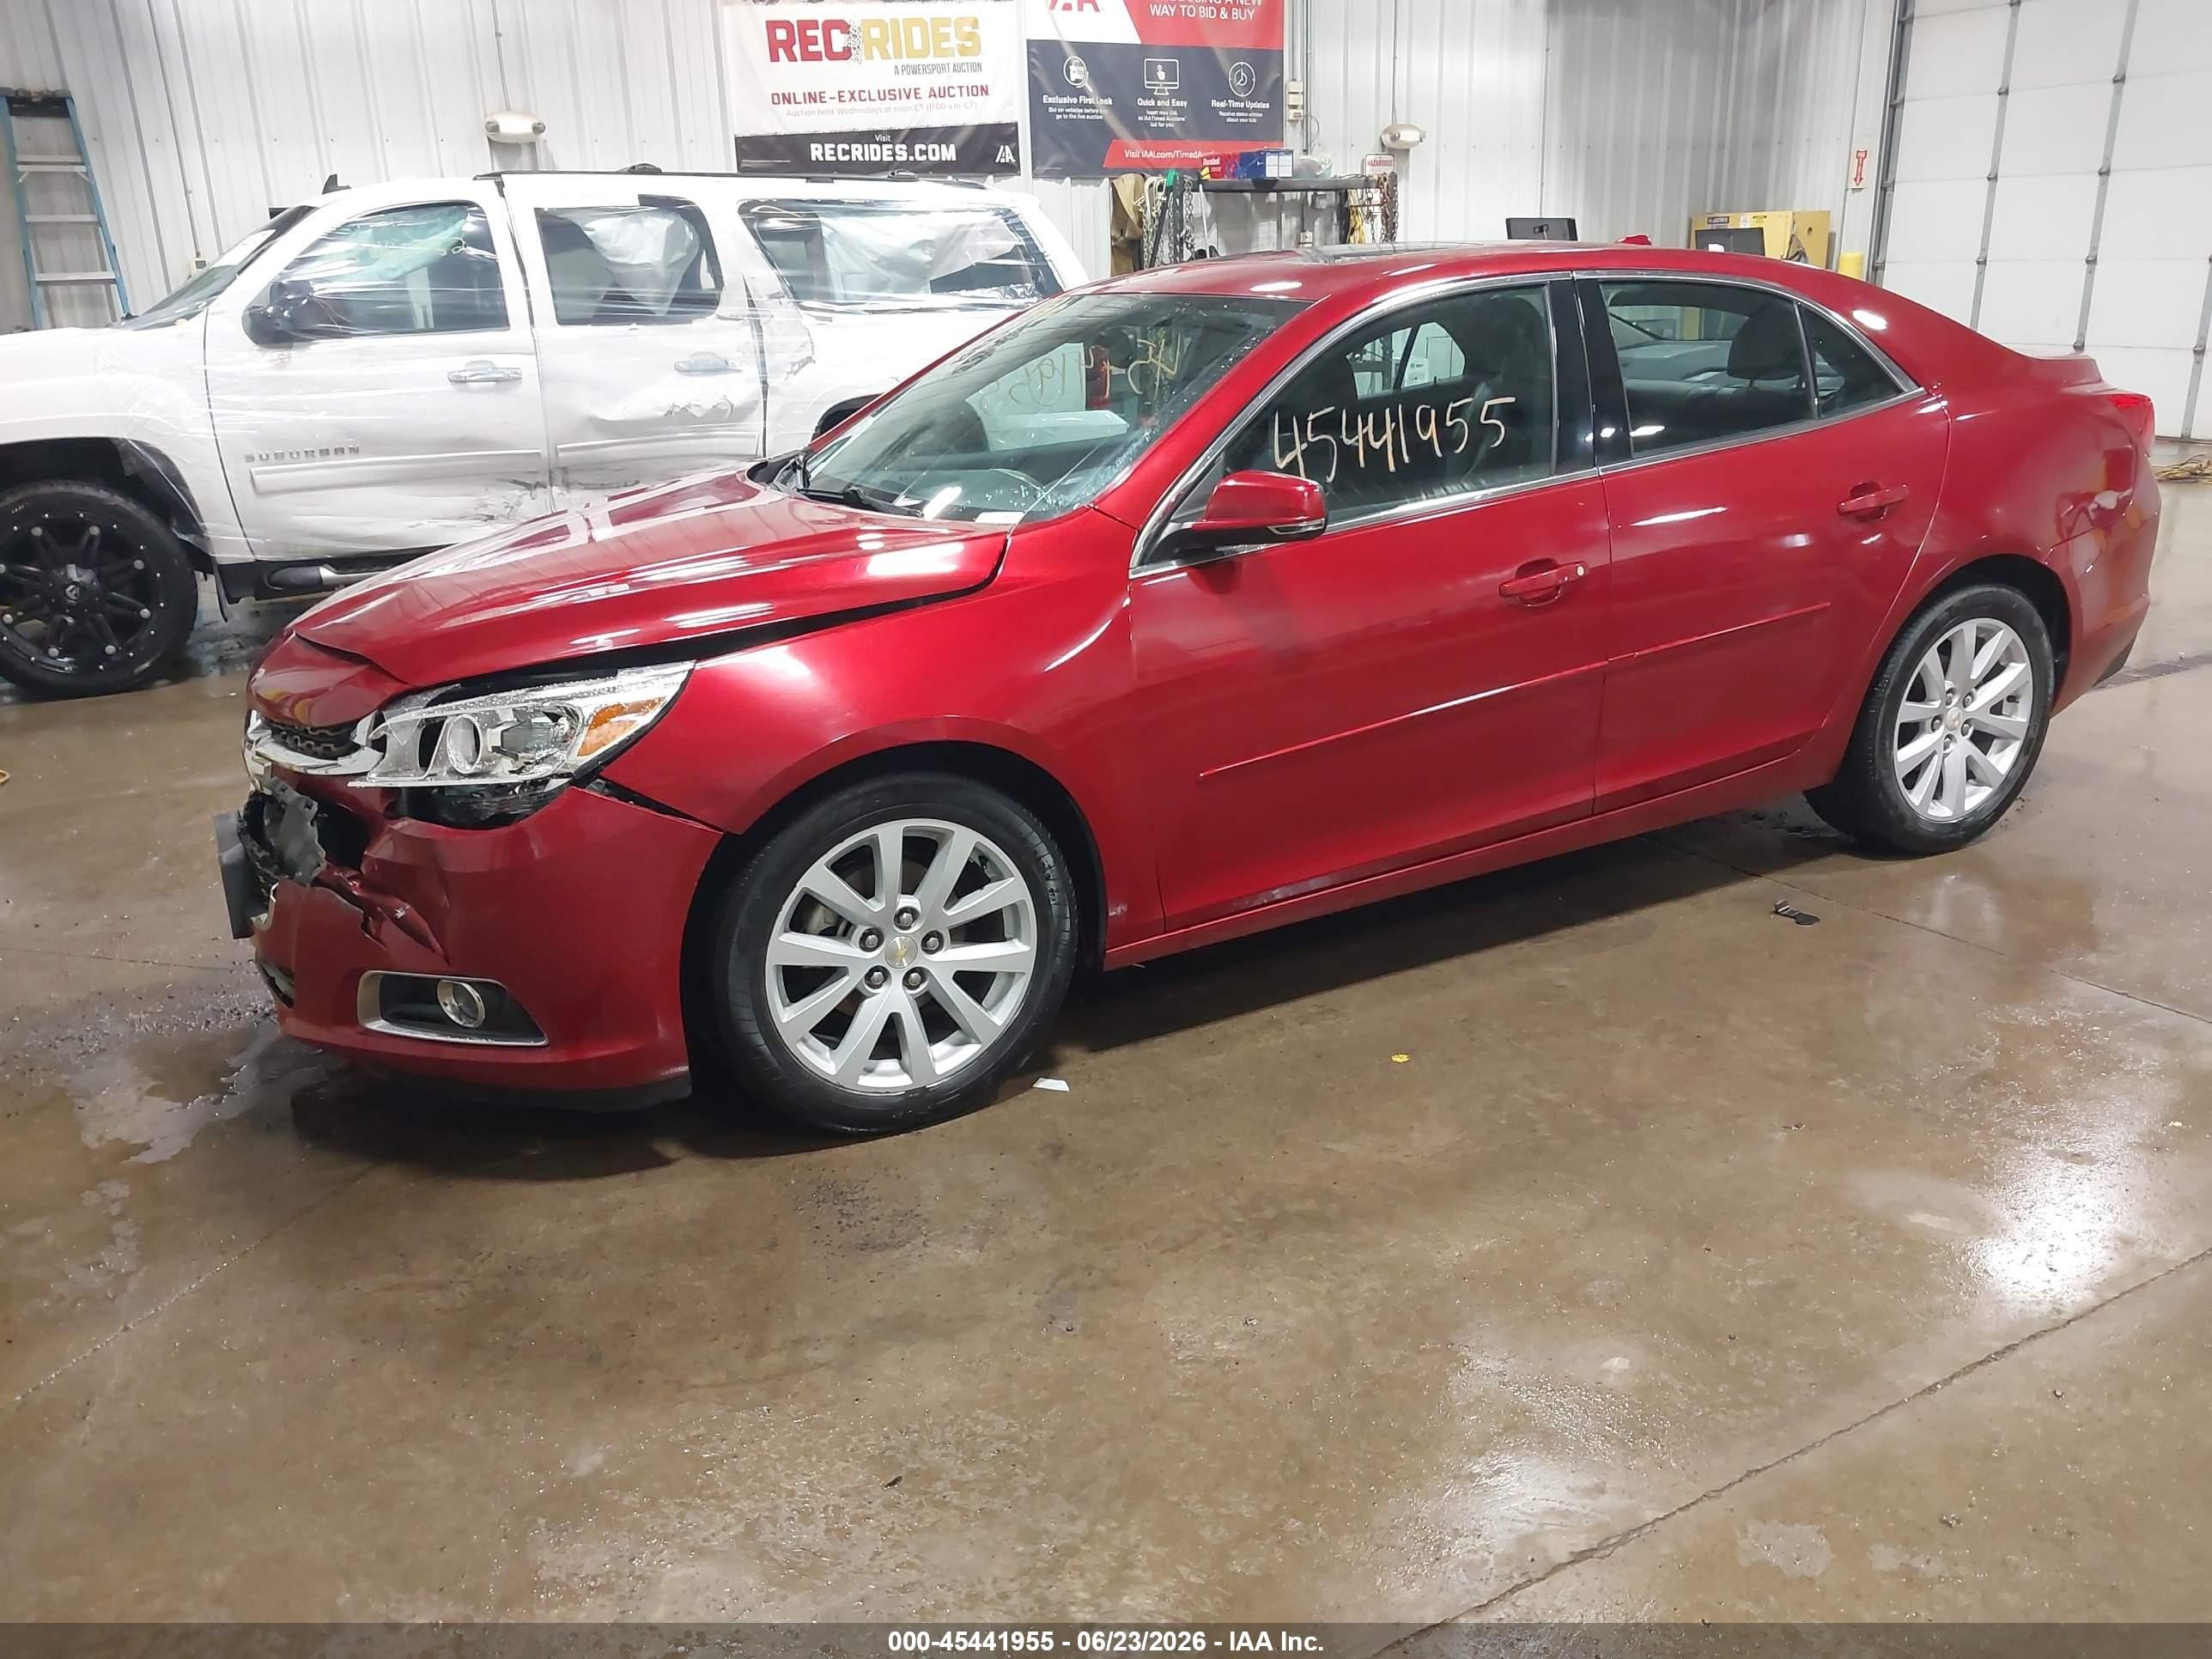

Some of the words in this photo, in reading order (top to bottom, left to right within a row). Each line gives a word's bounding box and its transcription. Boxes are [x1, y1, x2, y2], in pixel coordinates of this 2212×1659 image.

[1149, 3, 1176, 17] WAY
[1179, 4, 1195, 18] TO
[1199, 5, 1217, 19] BID
[1219, 7, 1229, 20] &
[1231, 8, 1255, 21] BUY
[765, 19, 854, 63] REC
[860, 16, 982, 60] RIDES
[894, 64, 900, 76] A
[901, 63, 951, 76] POWERSPORT
[952, 61, 982, 74] AUCTION
[770, 87, 921, 106] ONLINE-EXCLUSIVE
[927, 84, 990, 99] AUCTION
[1042, 94, 1079, 105] Exclusive
[1137, 97, 1156, 106] Quick
[1157, 98, 1170, 106] and
[1171, 98, 1188, 108] Easy
[1211, 99, 1244, 108] Real-Time
[1245, 100, 1270, 110] Updates
[874, 133, 891, 143] Visit
[810, 142, 957, 162] RECRIDES.COM
[1124, 149, 1141, 158] Visit
[1273, 396, 1516, 483] 45441955
[244, 444, 361, 464] SUBURBAN
